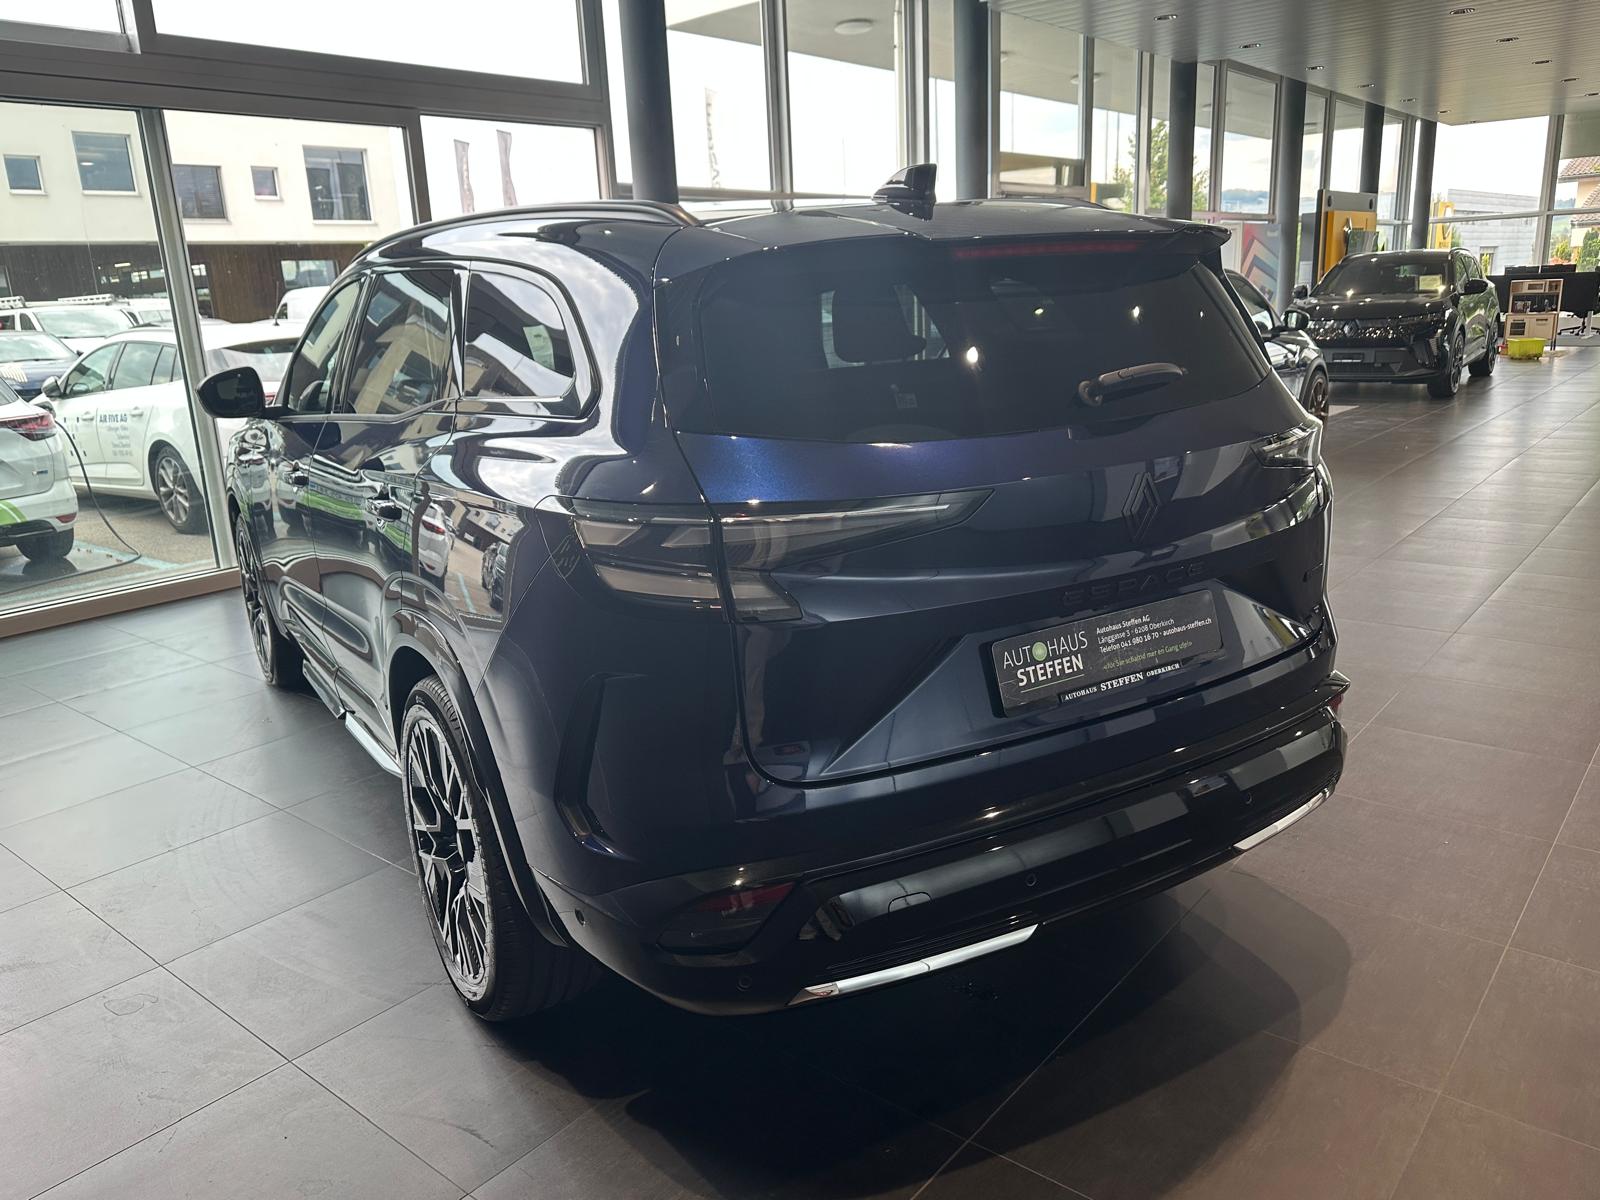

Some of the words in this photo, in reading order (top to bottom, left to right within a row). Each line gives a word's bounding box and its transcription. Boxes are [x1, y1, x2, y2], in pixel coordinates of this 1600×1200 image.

[1063, 561, 1204, 607] ESPACE
[1096, 623, 1122, 634] Autohaus
[1122, 617, 1142, 629] Steffen
[1142, 614, 1150, 623] AG
[1098, 630, 1126, 644] Länggasse
[1126, 629, 1131, 638] 3
[1134, 625, 1149, 634] 6208
[1149, 618, 1175, 630] Oberkirch
[1099, 642, 1121, 653] Telefon
[1120, 639, 1131, 649] 041
[1151, 631, 1160, 639] 70
[1163, 618, 1212, 637] autohaus-steffen.ch
[1003, 630, 1088, 669] AUTOHAUS
[1016, 653, 1084, 687] STEFFEN
[1064, 687, 1098, 700] AUTOHAUS
[1100, 672, 1144, 691] STEFFEN
[1146, 663, 1180, 676] OBERKIRCH
